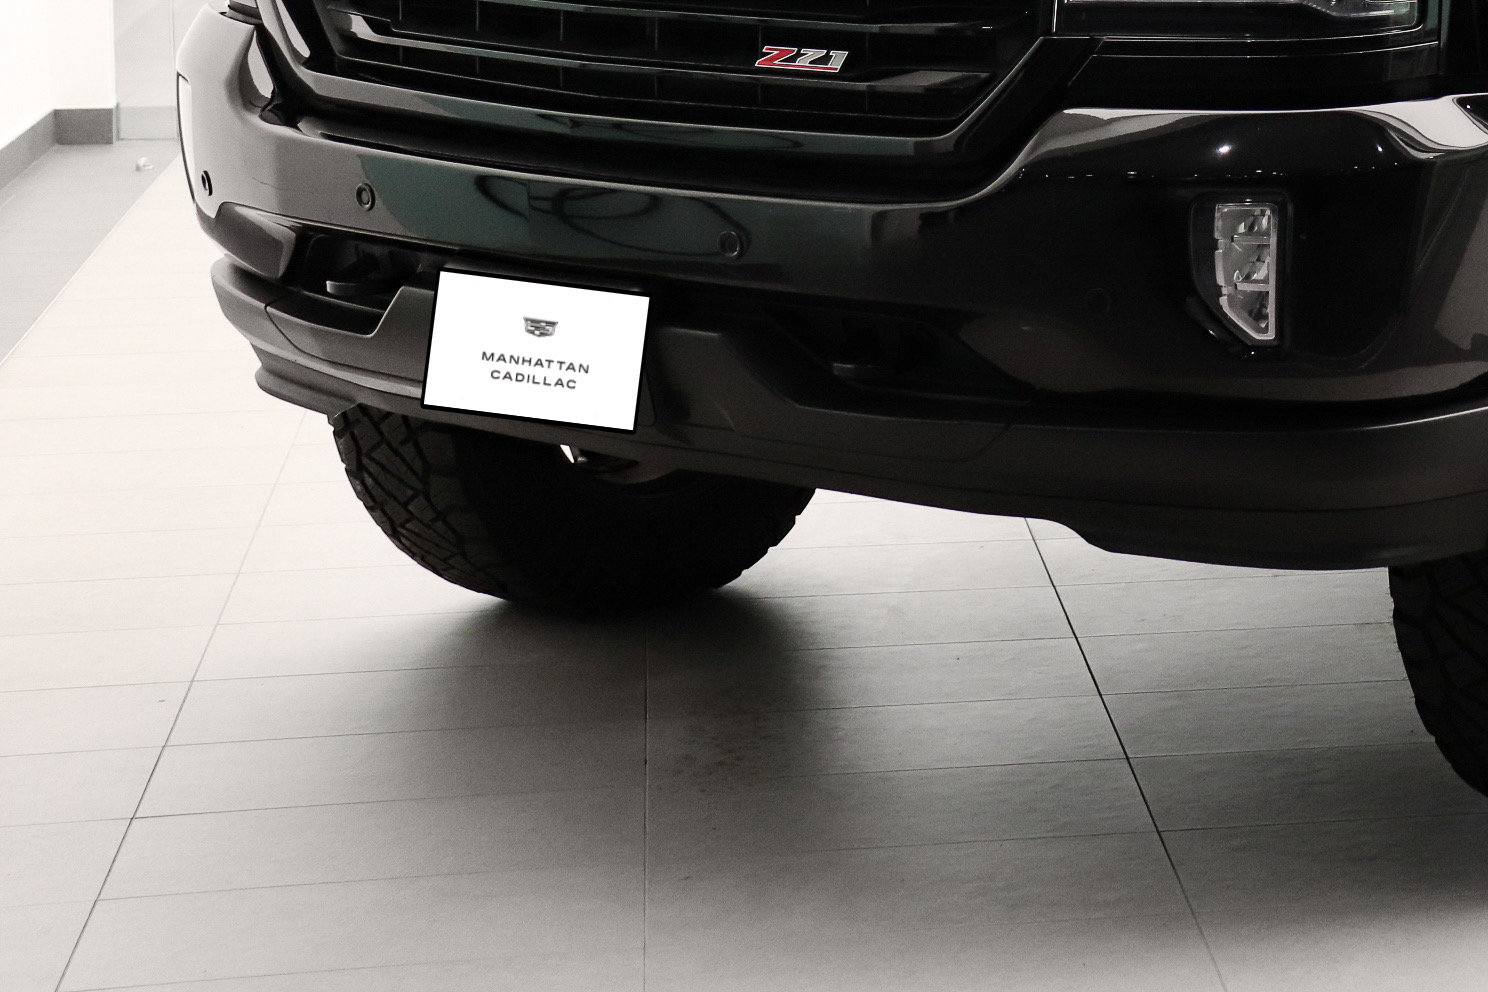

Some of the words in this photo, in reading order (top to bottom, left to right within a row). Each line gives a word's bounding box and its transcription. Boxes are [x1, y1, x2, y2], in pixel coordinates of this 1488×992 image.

[755, 46, 849, 73] Z71
[481, 351, 590, 374] MANHATTAN
[490, 369, 577, 390] CADILLAC
